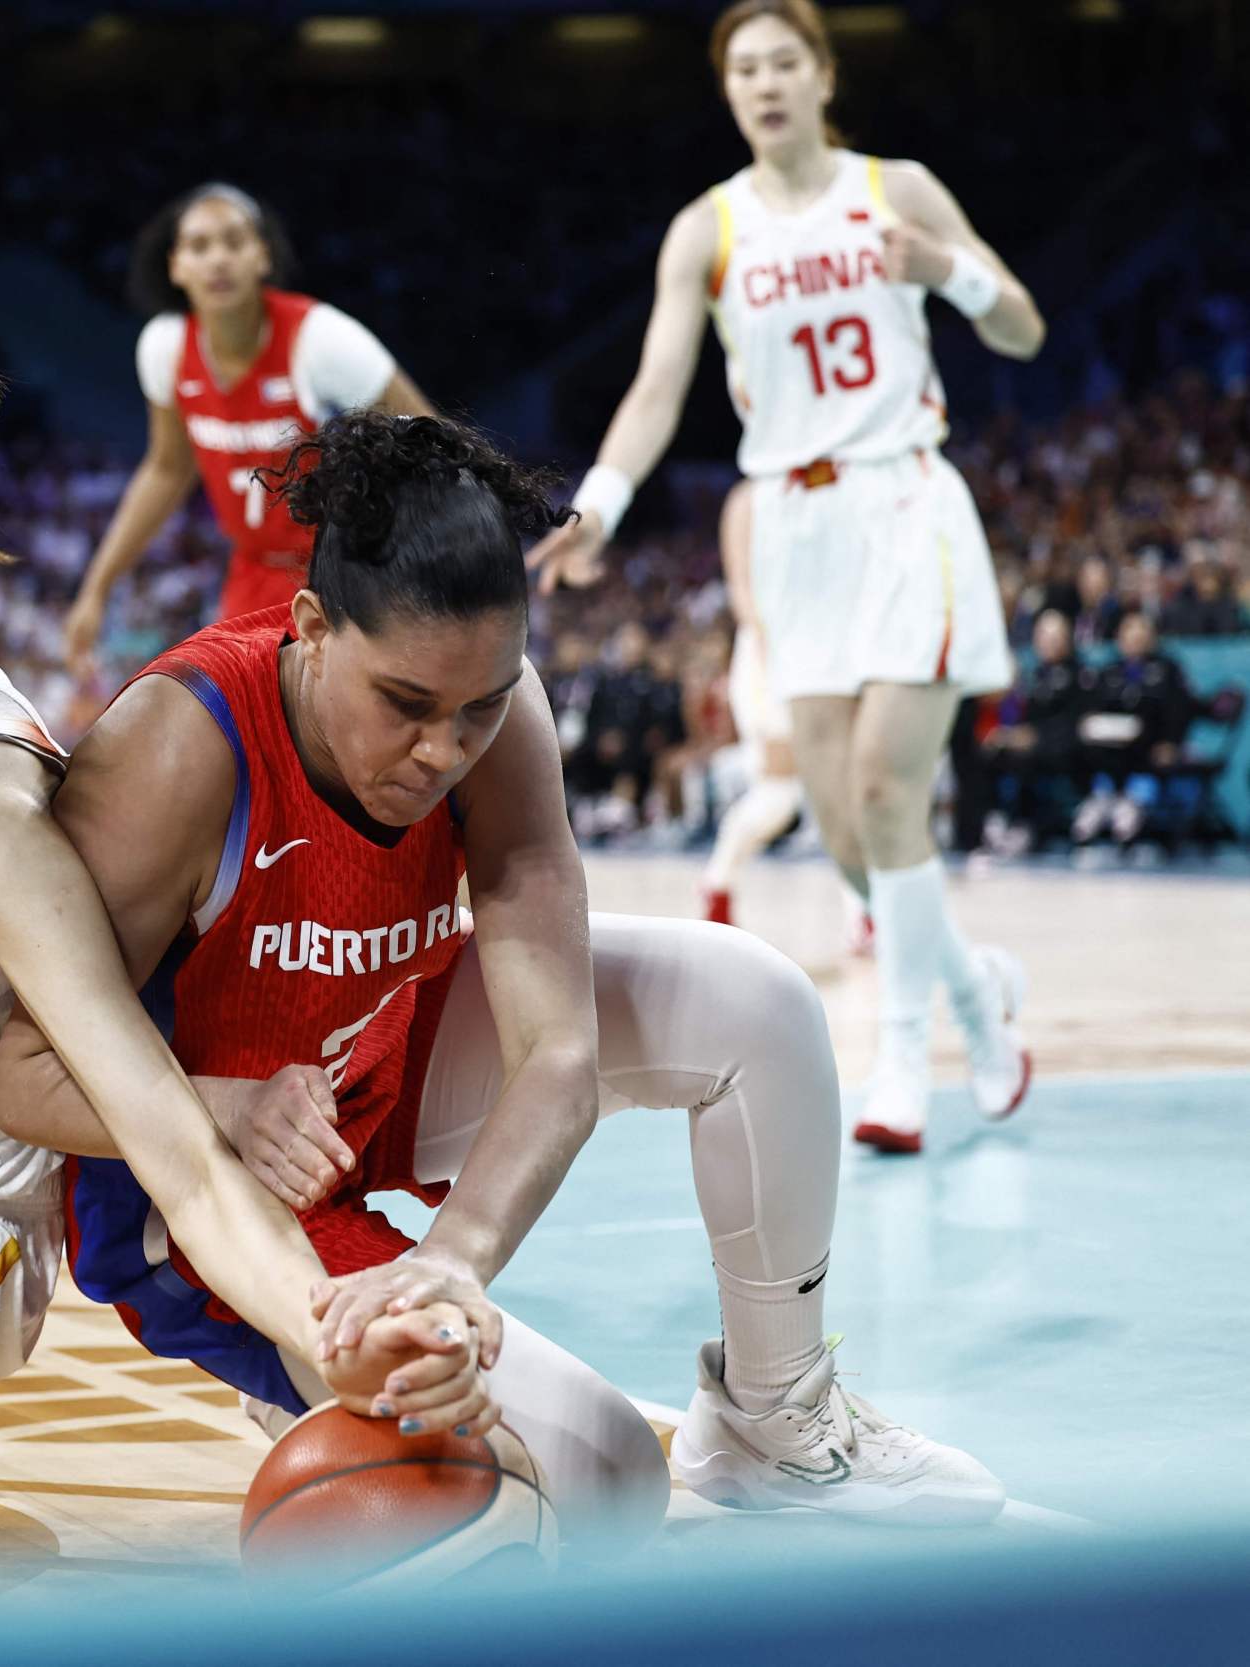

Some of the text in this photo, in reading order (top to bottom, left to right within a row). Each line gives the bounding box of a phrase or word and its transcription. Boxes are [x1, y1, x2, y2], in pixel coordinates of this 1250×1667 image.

[743, 248, 888, 309] CHINA
[791, 313, 877, 396] 13
[249, 919, 418, 977] PUERTO
